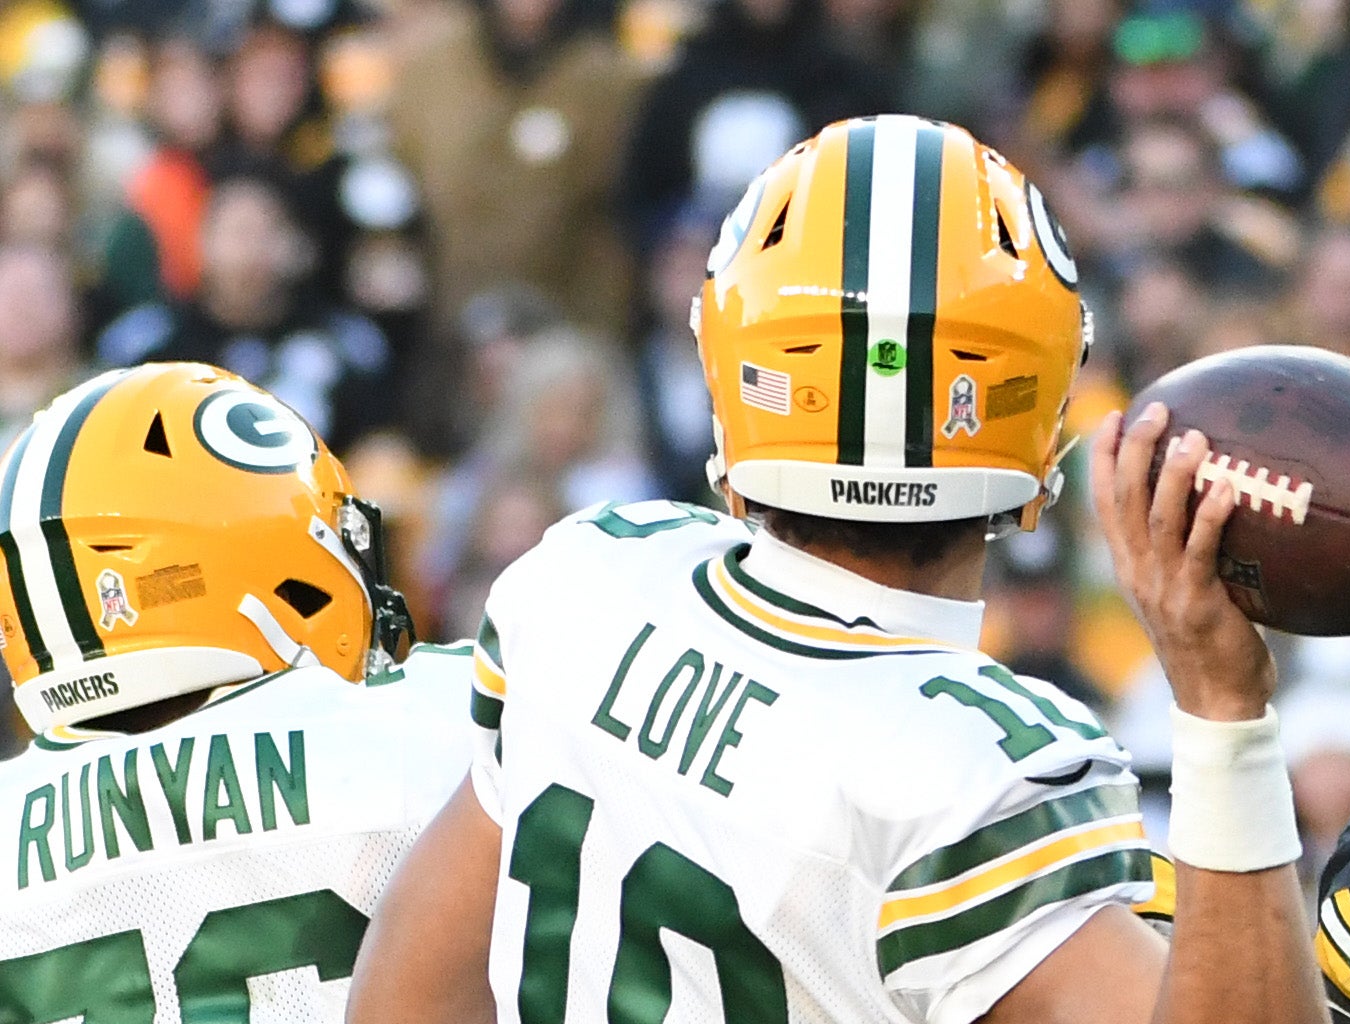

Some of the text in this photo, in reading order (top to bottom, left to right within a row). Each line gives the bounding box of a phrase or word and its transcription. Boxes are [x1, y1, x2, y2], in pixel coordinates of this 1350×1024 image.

[830, 478, 938, 507] PACKERS
[40, 671, 120, 713] PACKERS
[590, 622, 781, 798] LOVE
[17, 729, 311, 890] RUNYAN
